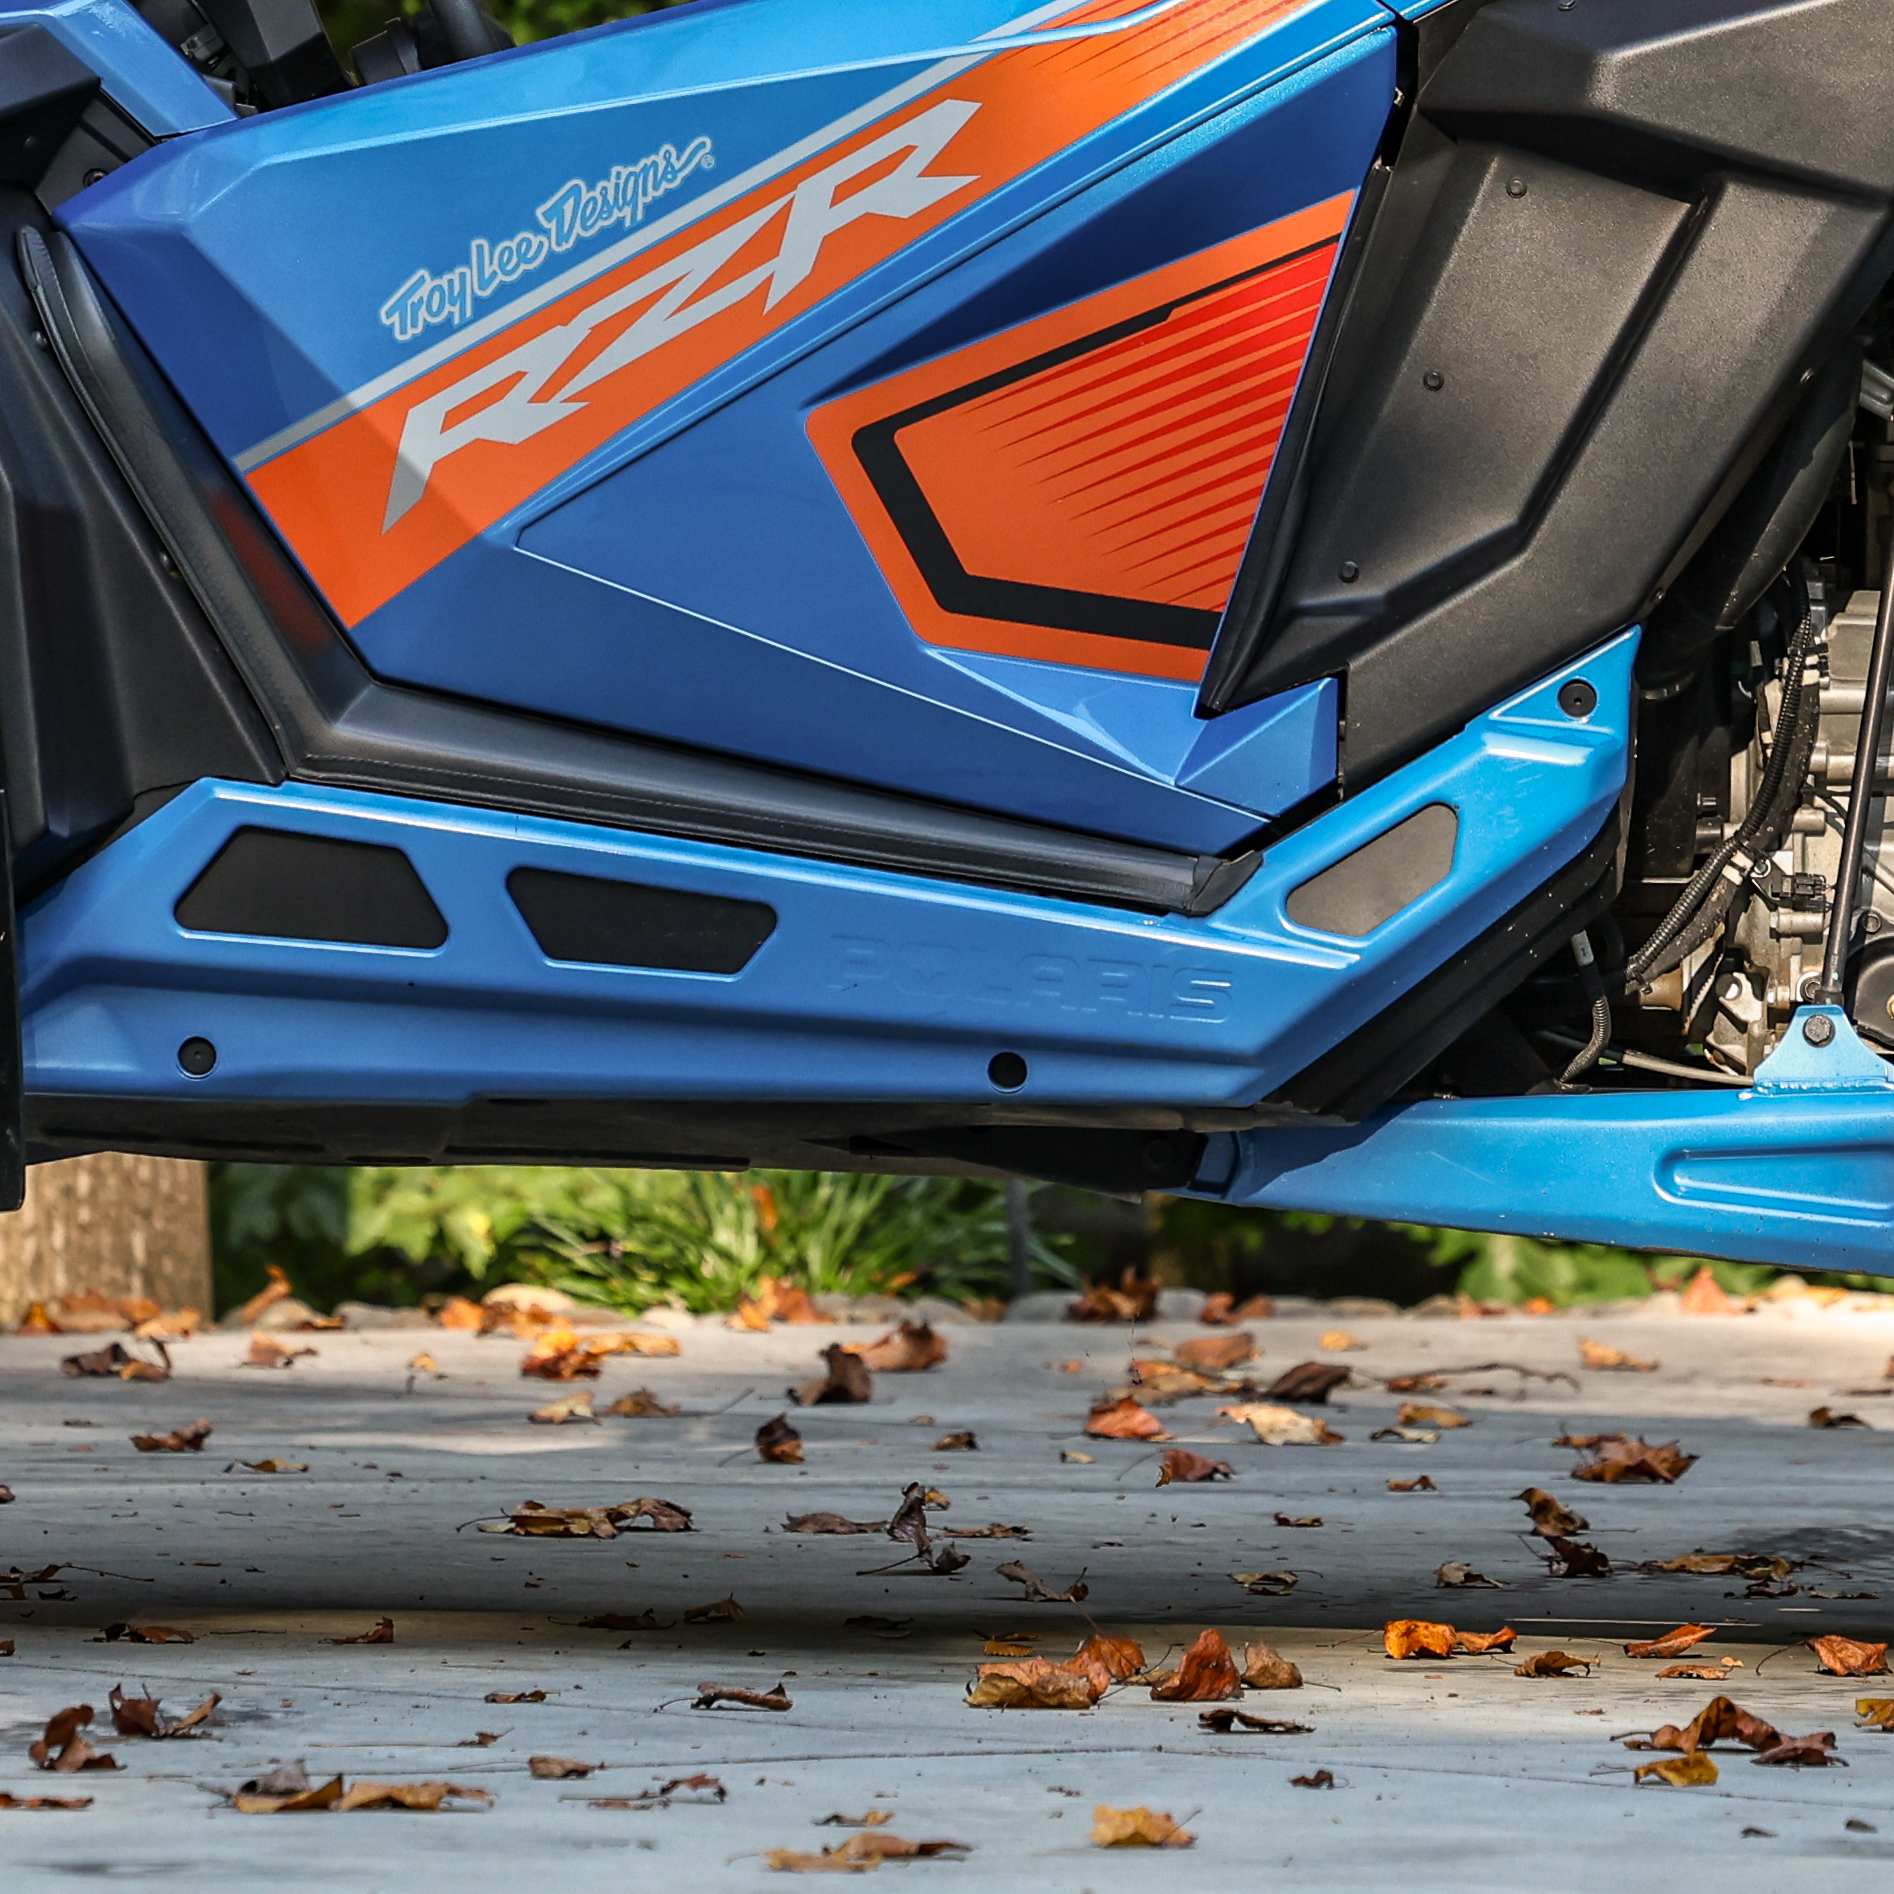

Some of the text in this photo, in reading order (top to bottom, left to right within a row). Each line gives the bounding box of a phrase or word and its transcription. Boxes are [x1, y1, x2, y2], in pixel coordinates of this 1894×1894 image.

[380, 268, 472, 342] Troy
[471, 238, 549, 297] Lee
[381, 99, 983, 536] RZR
[827, 934, 1234, 1024] POLARIS
